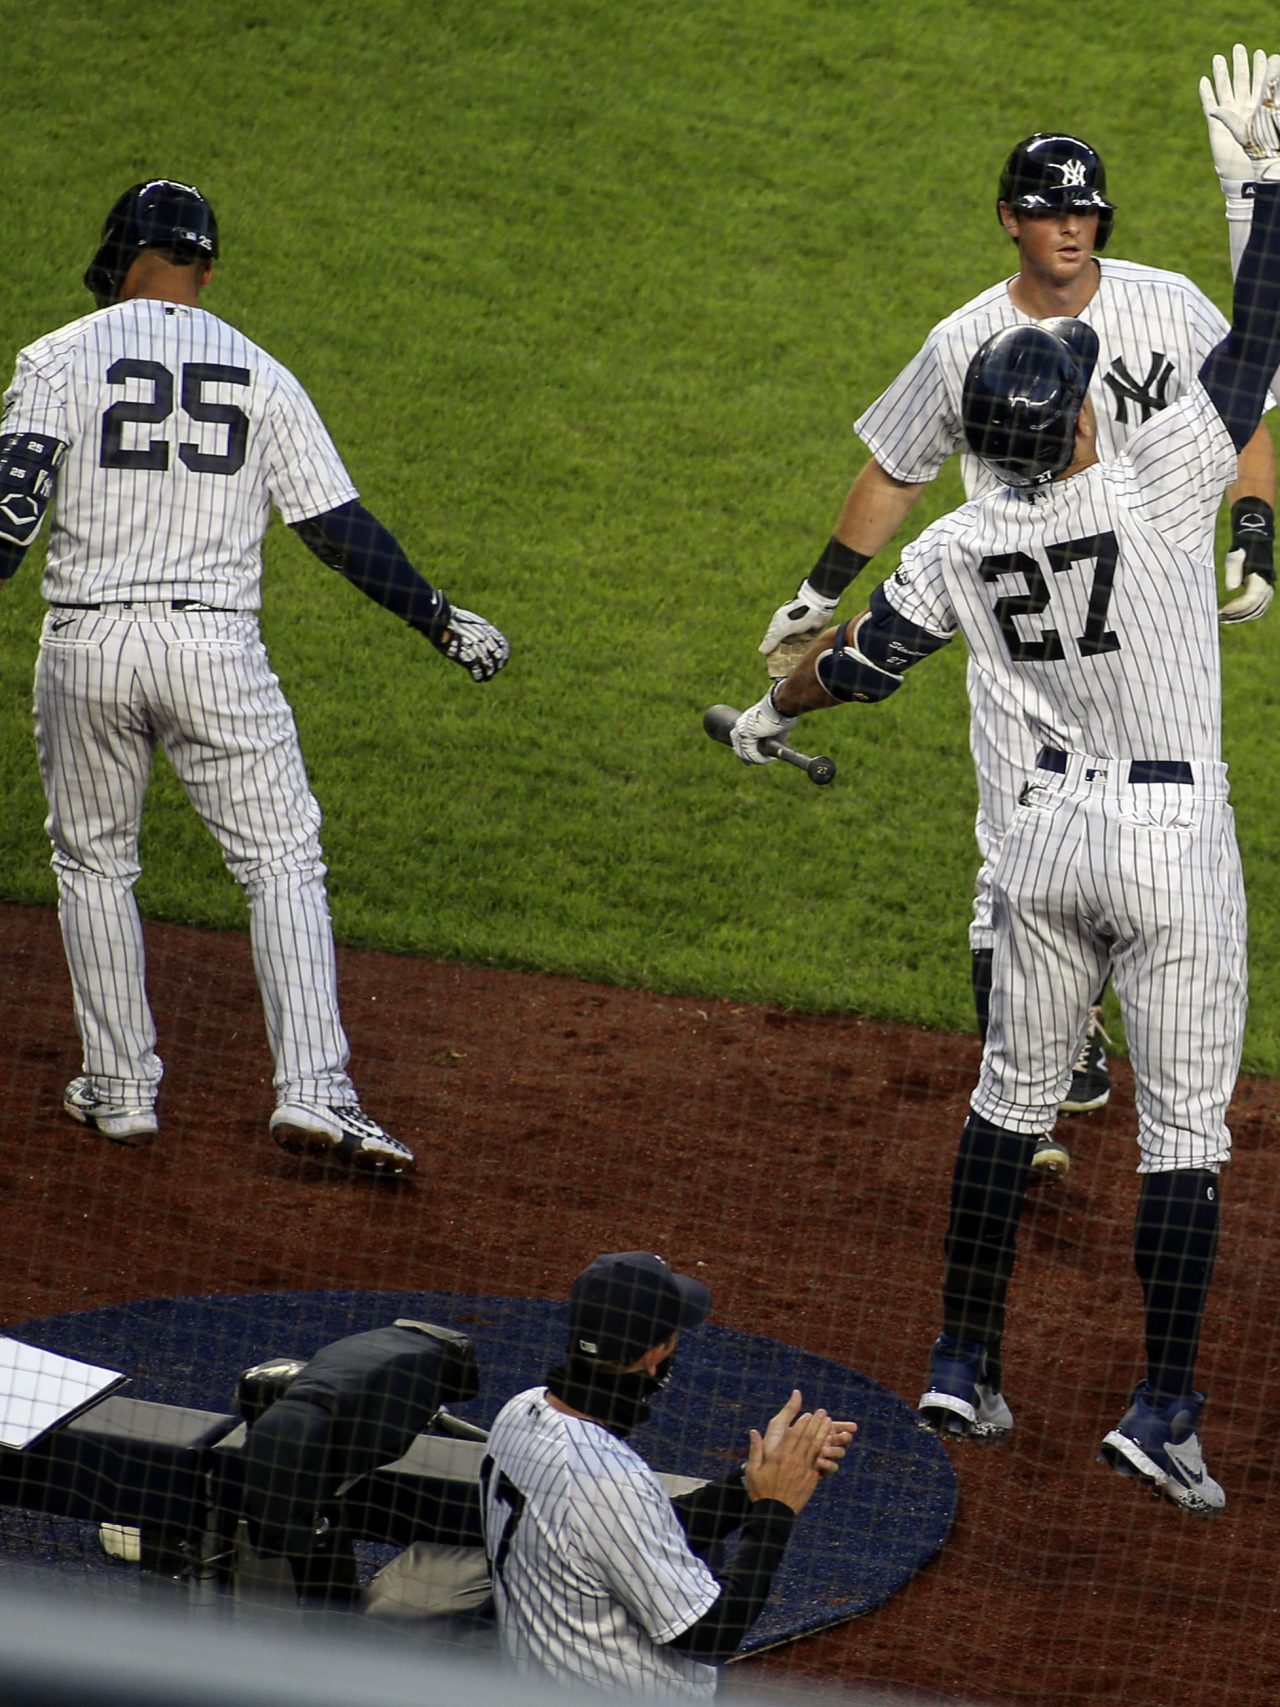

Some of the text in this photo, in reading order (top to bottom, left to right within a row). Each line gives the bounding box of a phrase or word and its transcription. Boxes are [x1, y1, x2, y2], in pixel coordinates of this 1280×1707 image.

[1062, 159, 1086, 187] NY
[198, 235, 212, 250] 25
[1102, 351, 1175, 425] NY
[99, 358, 250, 476] 25
[27, 441, 45, 454] 25
[9, 467, 27, 479] 25
[1035, 470, 1052, 483] 27
[978, 530, 1122, 662] 27
[886, 656, 908, 665] 27
[816, 766, 828, 775] 27
